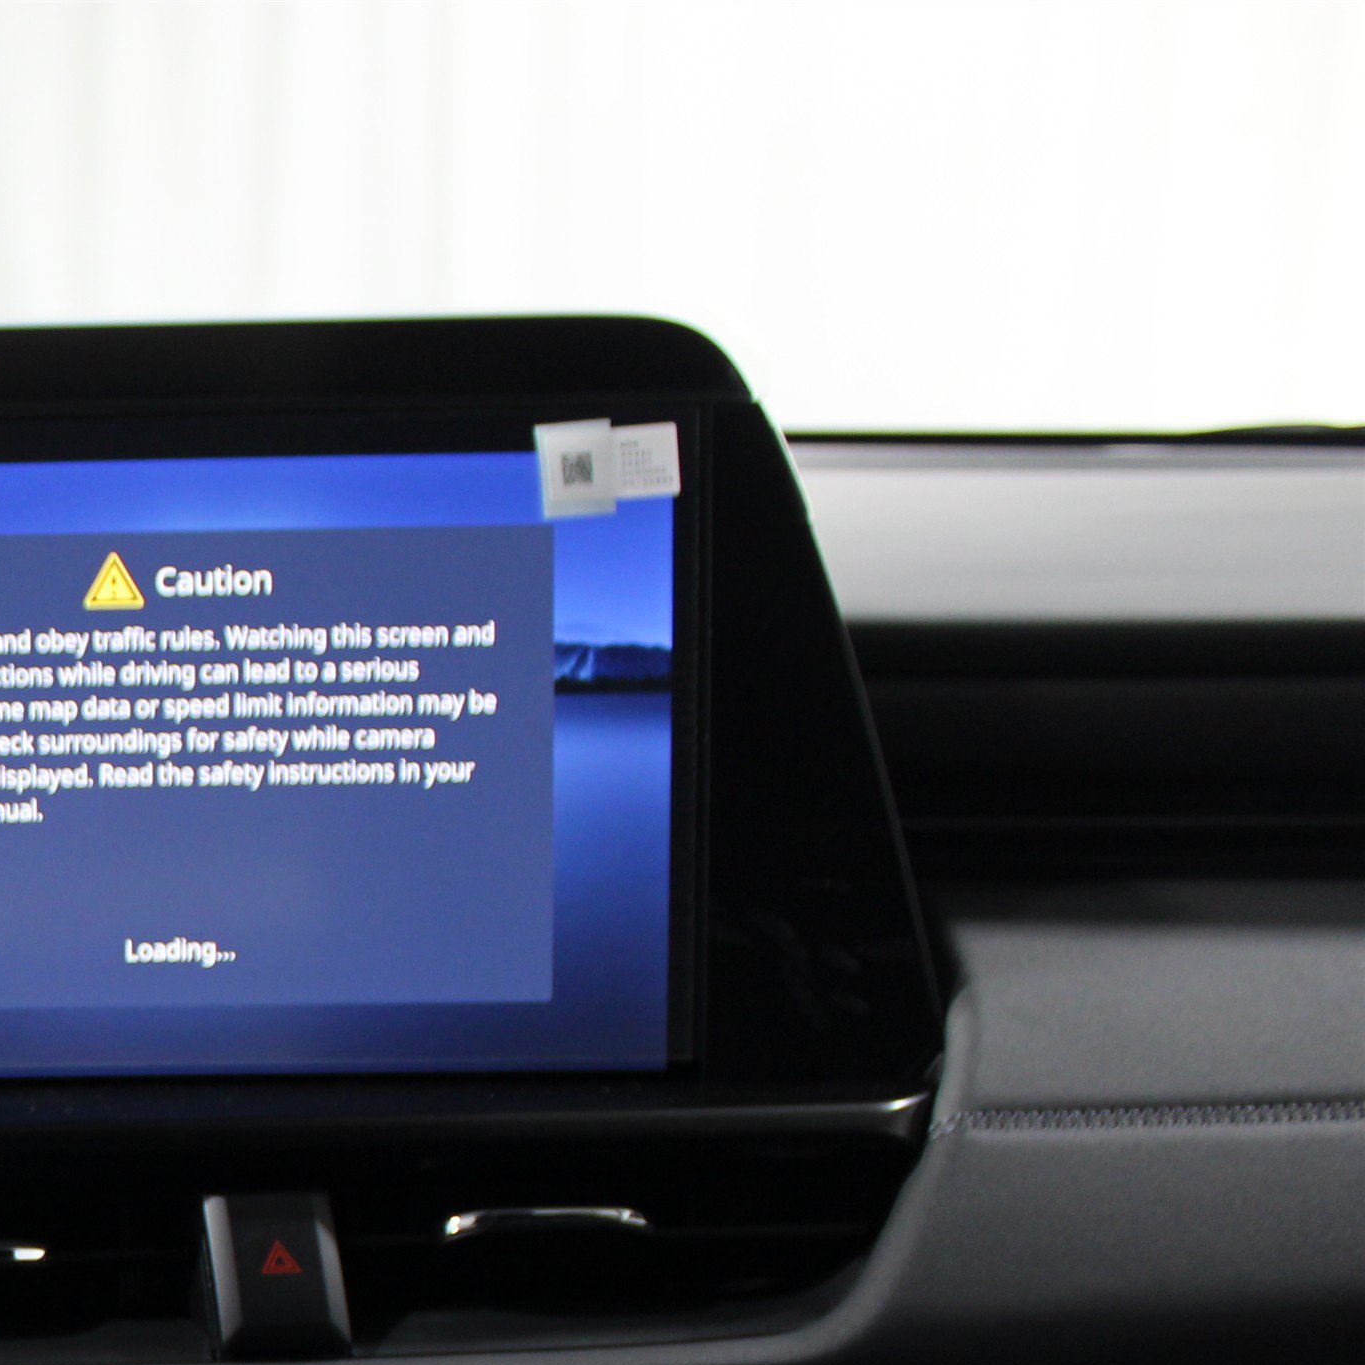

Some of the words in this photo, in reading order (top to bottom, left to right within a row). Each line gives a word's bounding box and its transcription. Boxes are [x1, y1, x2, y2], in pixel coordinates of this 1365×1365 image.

[156, 564, 272, 596] Caution
[36, 628, 89, 658] obey
[93, 626, 156, 651] traffic
[161, 626, 220, 650] rules.
[226, 624, 327, 654] Watching
[332, 623, 372, 647] this
[378, 626, 448, 647] screen
[454, 621, 495, 645] and
[58, 661, 115, 686] while
[121, 661, 195, 689] driving
[201, 664, 239, 683] can
[244, 658, 290, 683] lead
[295, 659, 319, 681] to
[322, 662, 336, 681] a
[342, 657, 419, 681] serious
[29, 700, 78, 724] map
[82, 695, 131, 719] data
[136, 699, 160, 718] or
[164, 693, 229, 722] speed
[234, 693, 283, 716] limit
[287, 691, 413, 715] information
[419, 694, 465, 719] may
[469, 689, 497, 713] be
[39, 728, 182, 758] surroundings
[188, 727, 219, 751] for
[223, 726, 289, 756] safety
[293, 725, 350, 749] while
[355, 728, 435, 749] camera
[100, 762, 153, 786] Read
[158, 762, 194, 785] the
[199, 760, 264, 790] safety
[269, 759, 395, 784] instructions
[400, 758, 420, 781] in
[426, 762, 475, 788] your
[126, 938, 235, 967] Loading...
